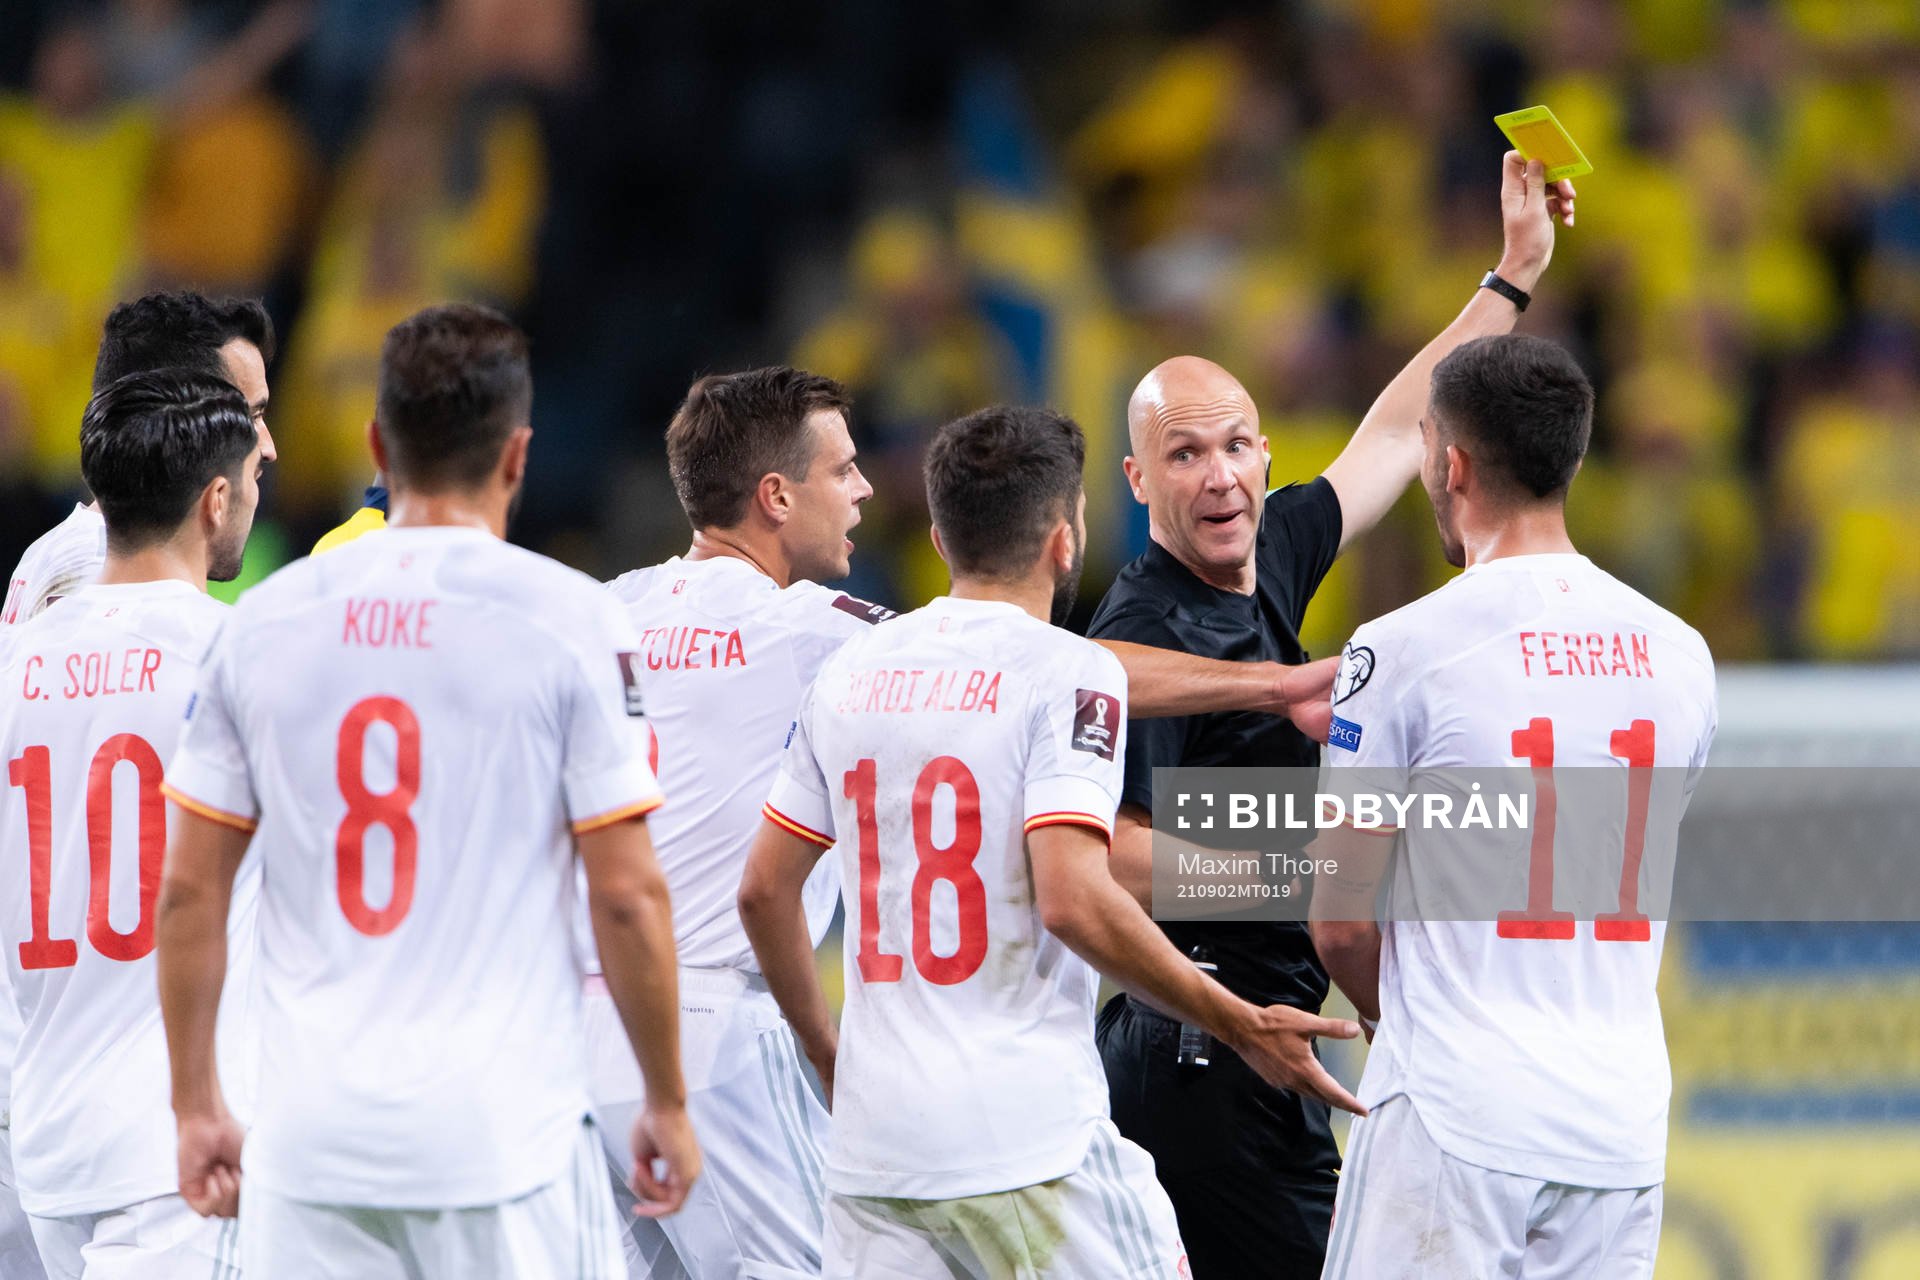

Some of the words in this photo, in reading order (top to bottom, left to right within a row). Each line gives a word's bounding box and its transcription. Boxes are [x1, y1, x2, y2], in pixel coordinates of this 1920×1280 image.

[22, 655, 50, 701] C.
[63, 648, 162, 700] SOLER
[342, 597, 438, 649] KOKE
[924, 669, 1002, 714] ALBA
[1519, 630, 1655, 679] FERRAN
[8, 732, 167, 970] 10
[334, 694, 422, 937] 8
[843, 754, 989, 986] 18
[1496, 716, 1656, 942] 11
